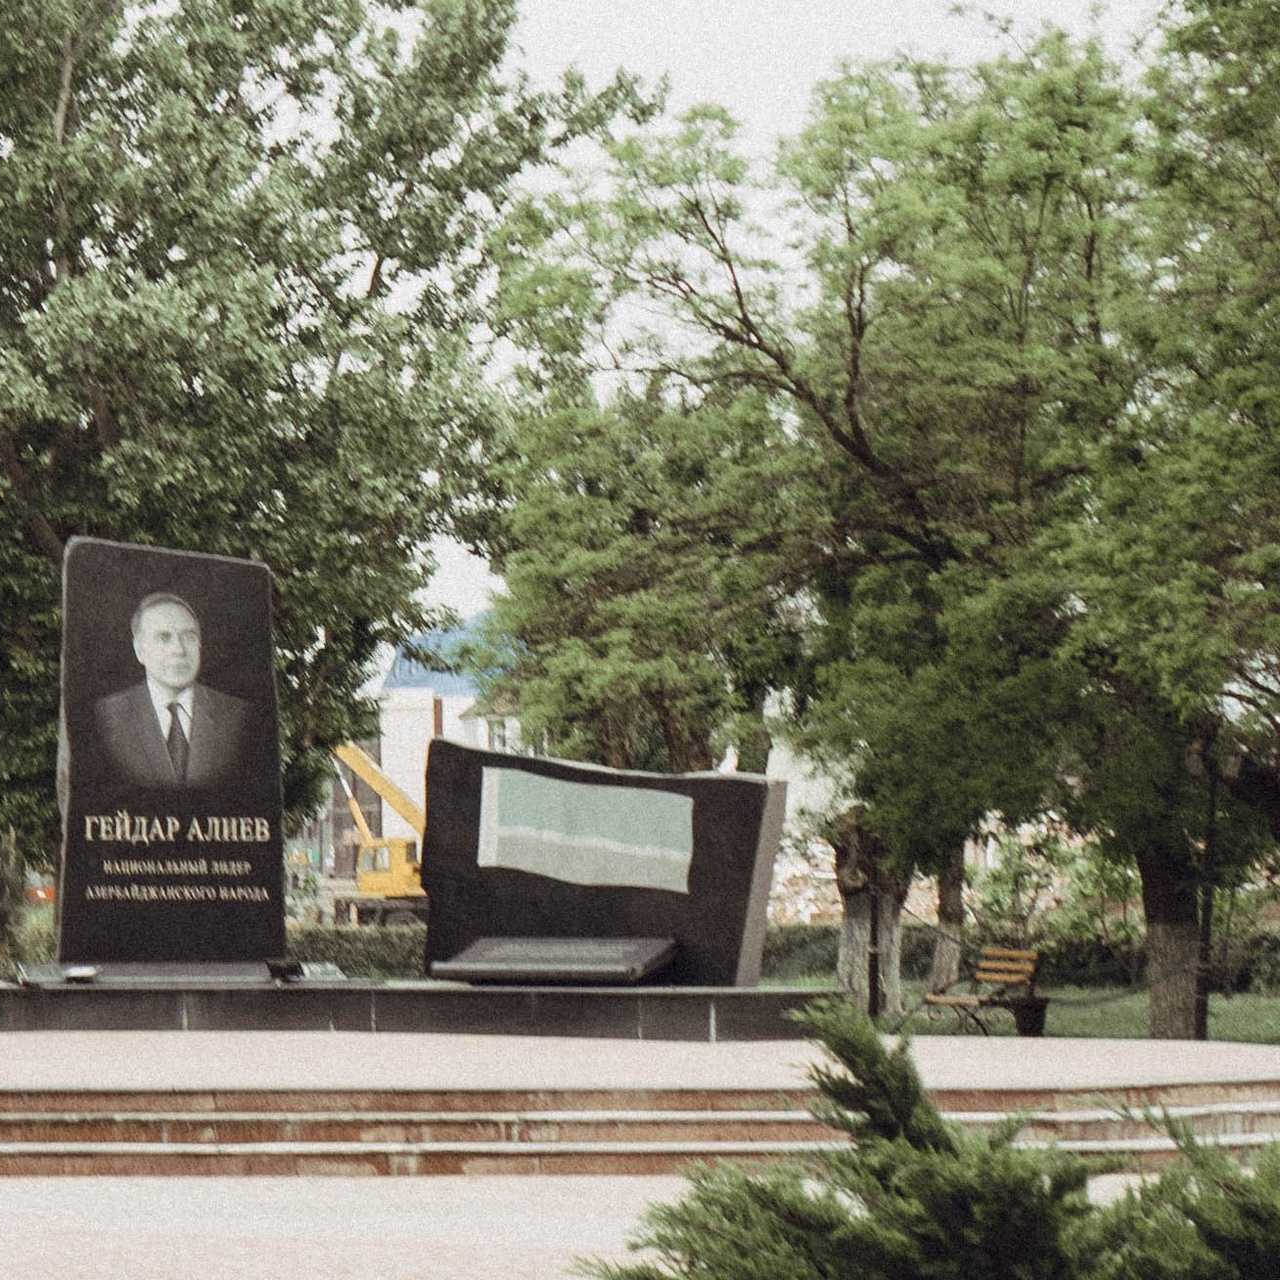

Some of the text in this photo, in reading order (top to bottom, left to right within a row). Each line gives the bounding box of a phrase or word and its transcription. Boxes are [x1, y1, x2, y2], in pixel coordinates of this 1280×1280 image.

[84, 809, 270, 846] ГЕЙДАР АЛИЕВ
[102, 857, 252, 876] НАЦИОНАЛЬНЫЙ ЛИДЕР
[85, 883, 270, 901] АЗЕРБАЙДЖАНСКОГО НАРОДА
